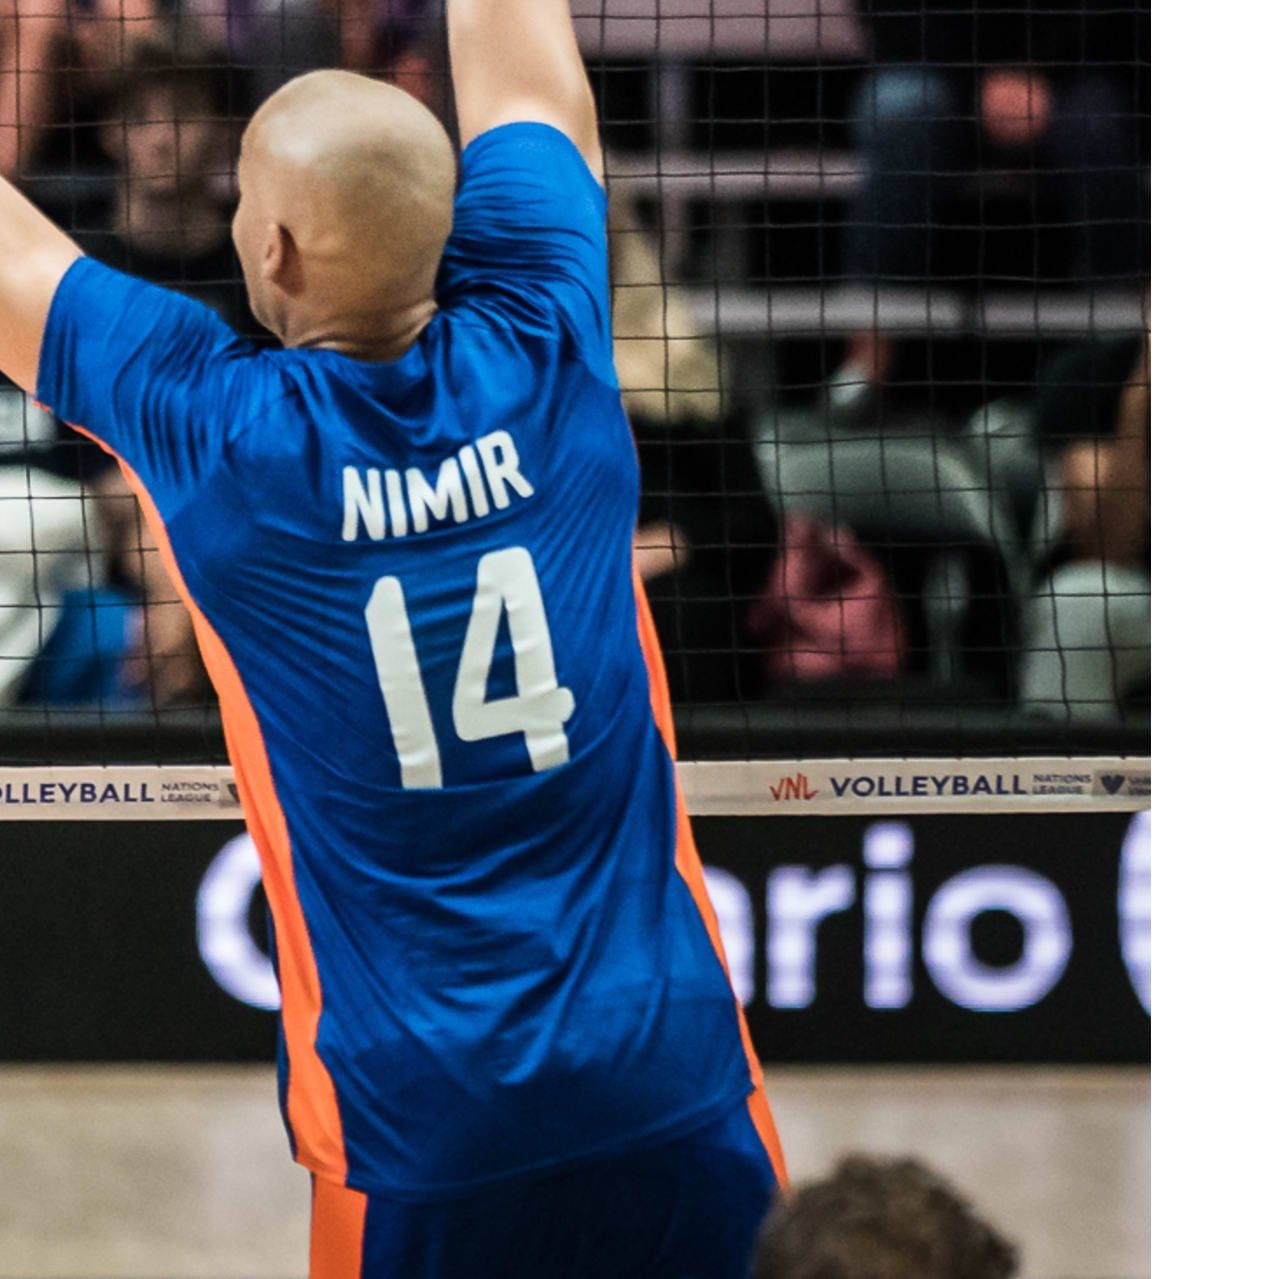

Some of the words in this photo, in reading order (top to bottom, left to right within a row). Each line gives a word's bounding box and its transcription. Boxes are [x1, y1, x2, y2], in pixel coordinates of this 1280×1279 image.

[342, 429, 535, 543] NIMIR
[364, 545, 576, 790] 14
[769, 772, 820, 802] VNL
[829, 775, 1028, 797] VOLLEYBALL
